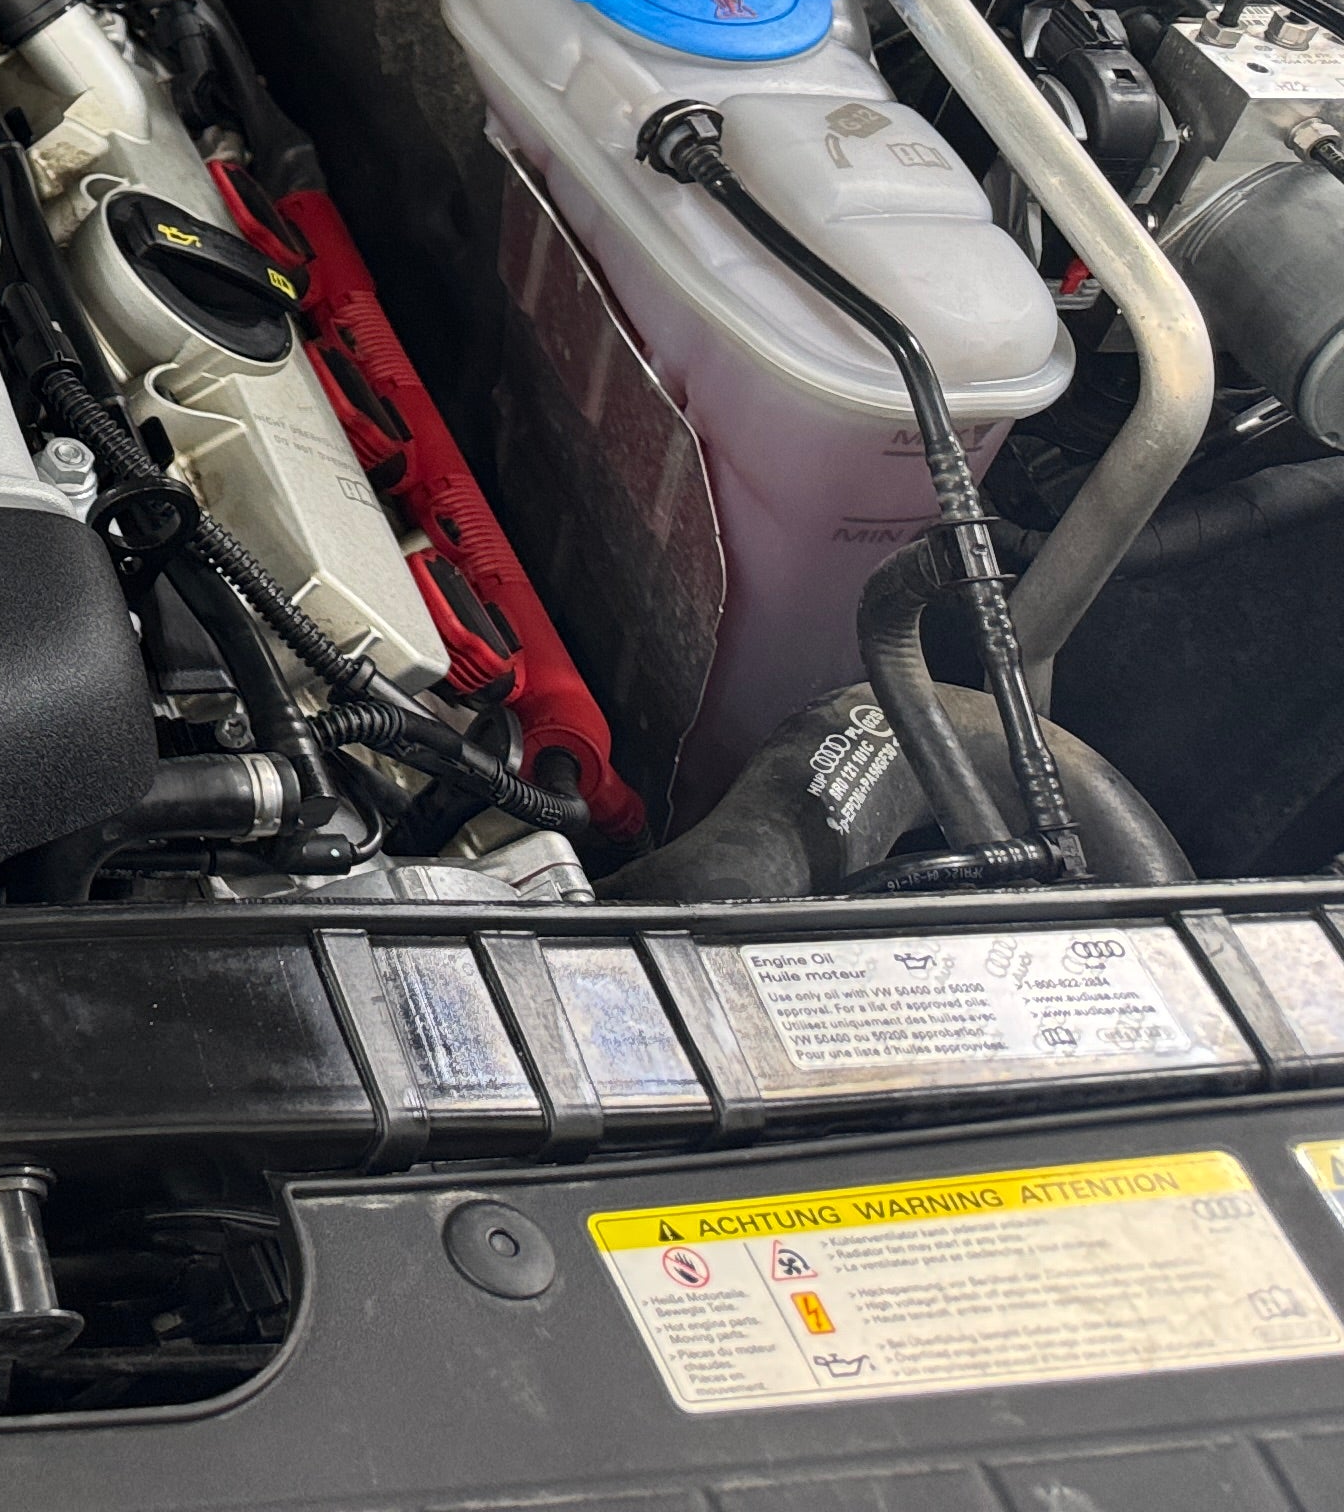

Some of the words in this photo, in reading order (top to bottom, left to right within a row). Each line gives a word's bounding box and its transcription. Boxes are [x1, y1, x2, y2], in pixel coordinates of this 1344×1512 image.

[840, 760, 860, 782] 121
[852, 740, 875, 766] 101C
[750, 955, 809, 969] Engine
[810, 953, 835, 964] Oil
[757, 971, 802, 983] Huile
[805, 969, 869, 981] moteur
[768, 993, 794, 1002] Use
[793, 991, 822, 1002] only
[823, 990, 841, 999] oil
[841, 989, 870, 998] with
[870, 988, 894, 997] VW
[932, 986, 948, 994] or
[834, 1003, 857, 1013] For
[867, 1002, 888, 1011] list
[889, 1001, 904, 1010] of
[903, 998, 963, 1011] approved
[781, 1020, 829, 1031] Utilisez
[828, 1016, 904, 1030] uniquement
[903, 1015, 928, 1025] des
[928, 1013, 967, 1023] huiles
[967, 1013, 998, 1021] avec
[790, 1035, 813, 1045] VW
[852, 1033, 871, 1042] ou
[795, 1049, 828, 1060] Pour
[827, 1049, 853, 1059] une
[853, 1046, 881, 1057] liste
[698, 1205, 842, 1238] ACHTUNG
[852, 1187, 1004, 1222] WARNING
[1019, 1171, 1179, 1205] ATTENTION
[664, 1323, 686, 1332] Hot
